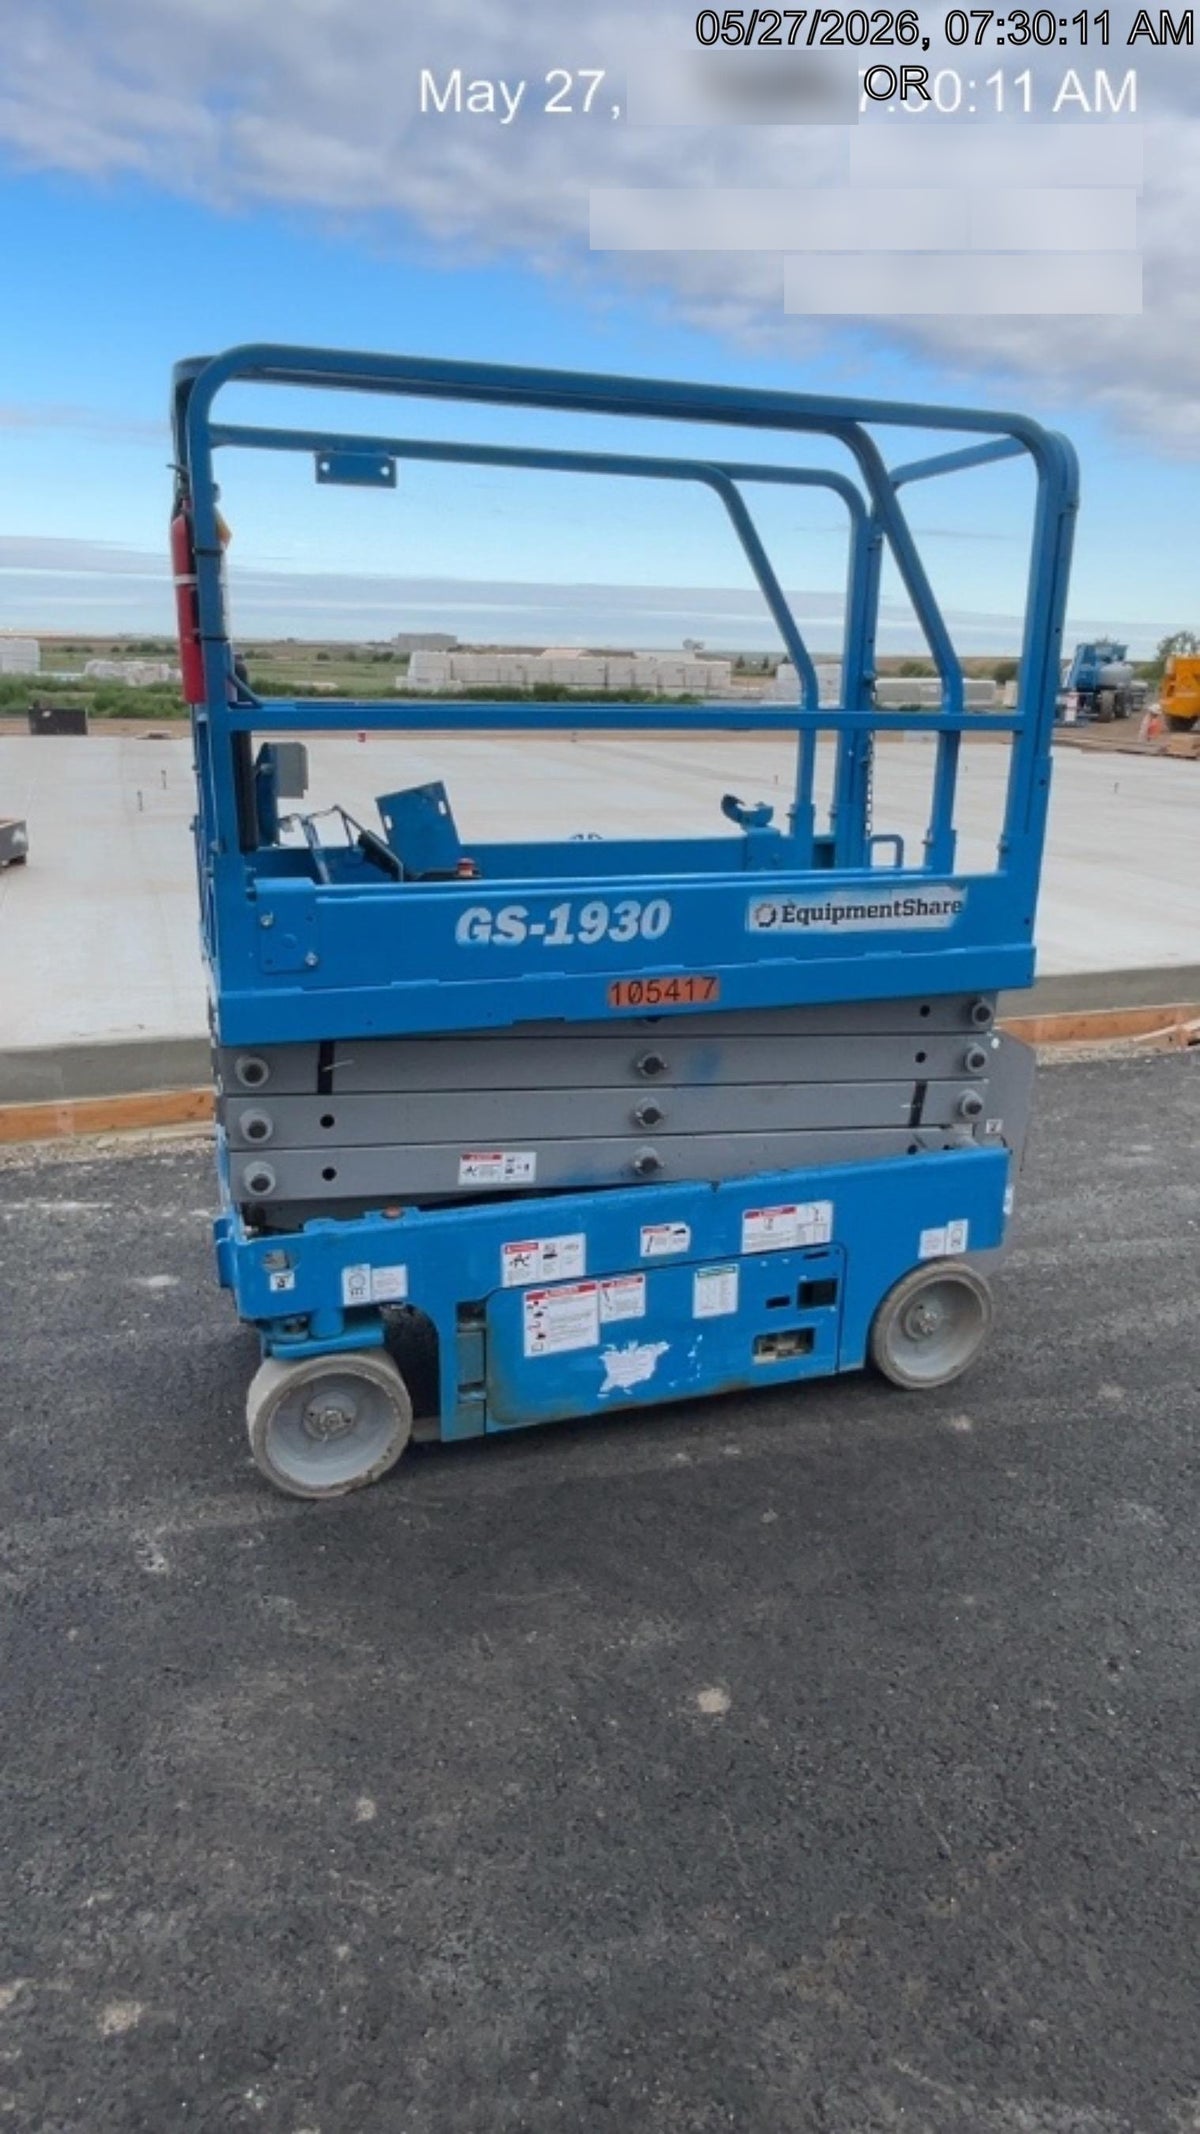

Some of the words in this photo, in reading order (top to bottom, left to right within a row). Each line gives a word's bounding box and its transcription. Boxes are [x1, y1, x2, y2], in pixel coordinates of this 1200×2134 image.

[455, 899, 672, 947] GS-1930
[781, 898, 963, 926] EquipmentShare
[610, 976, 718, 1007] 105417
